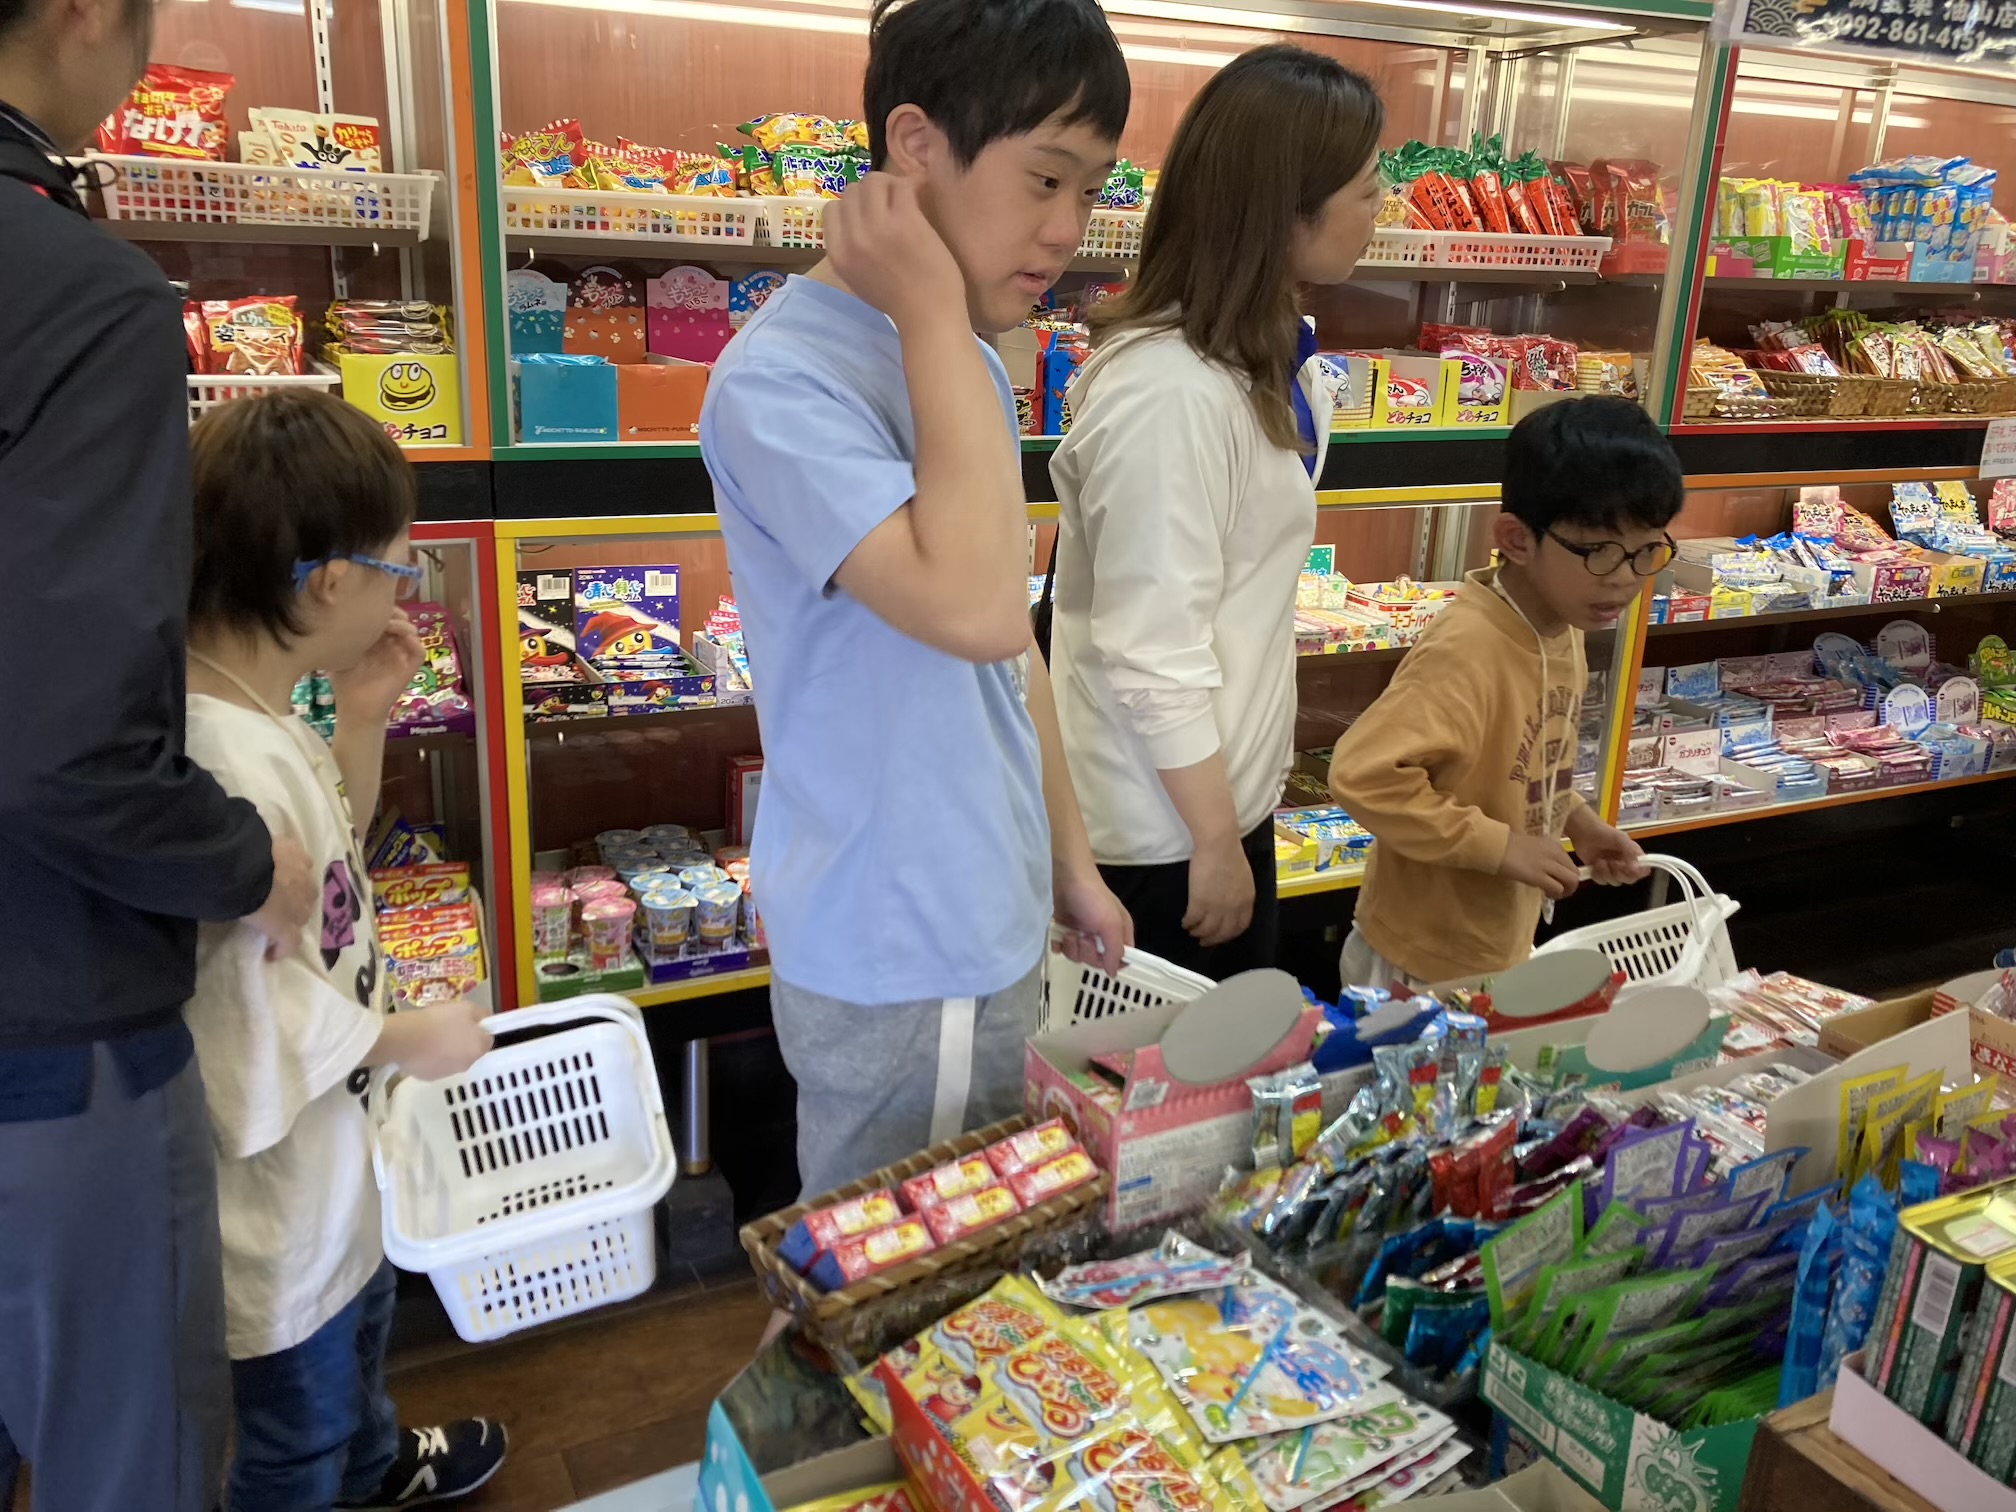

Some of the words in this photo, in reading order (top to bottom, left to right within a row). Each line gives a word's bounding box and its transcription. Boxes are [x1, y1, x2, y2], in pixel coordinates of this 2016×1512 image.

[783, 155, 844, 173] キャベツ
[666, 284, 709, 304] もちっと
[1386, 409, 1432, 425] どらチョコ
[1456, 409, 1499, 423] どらチョコ
[383, 420, 448, 440] らチョコ
